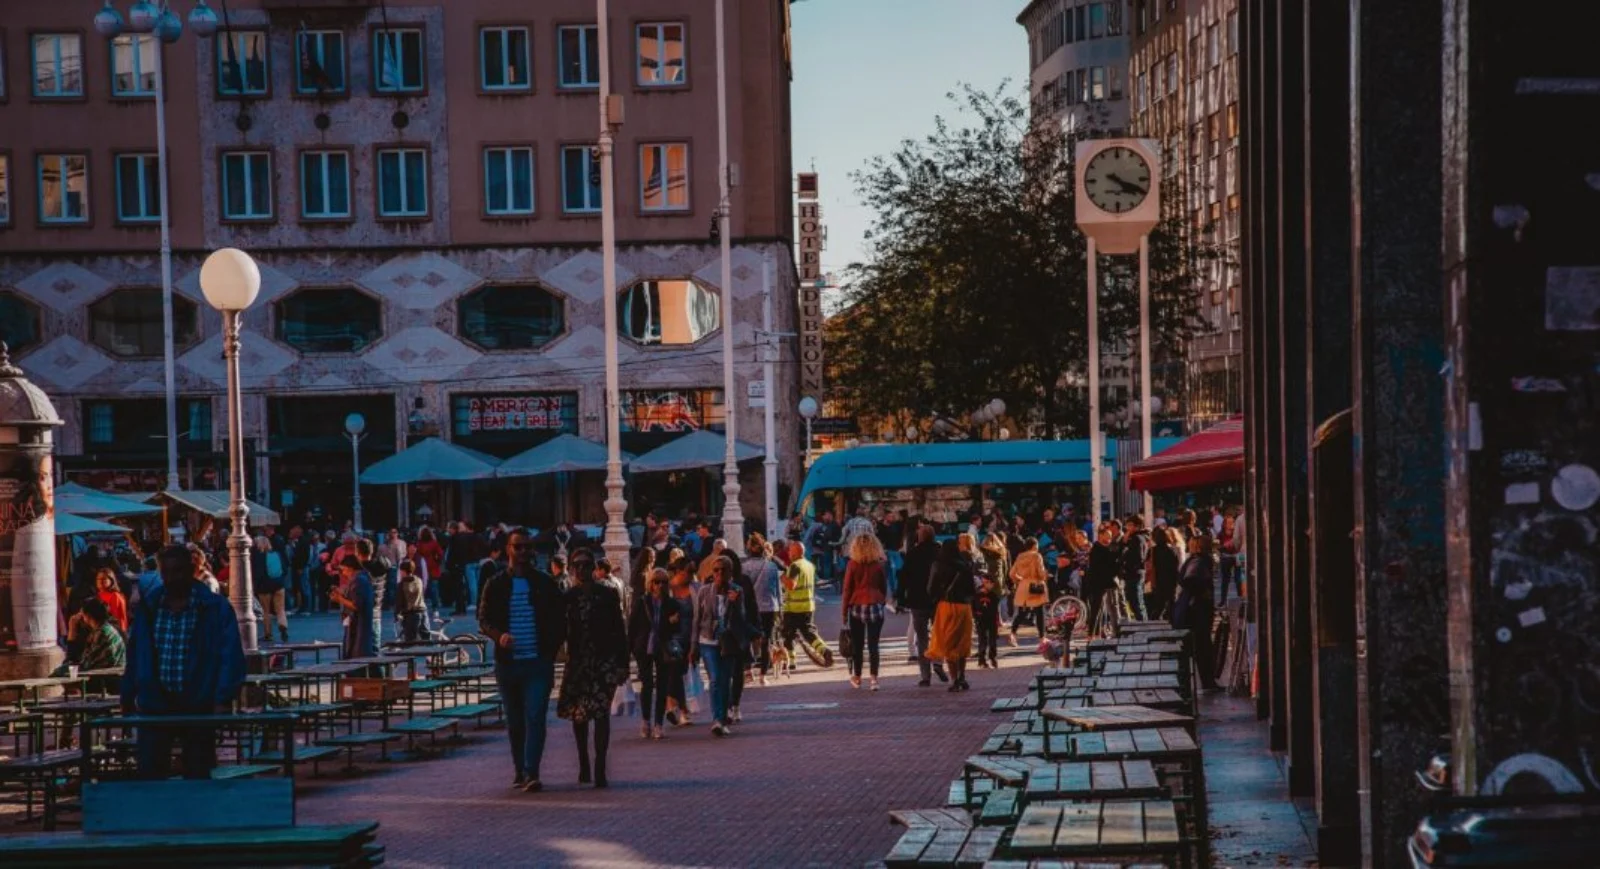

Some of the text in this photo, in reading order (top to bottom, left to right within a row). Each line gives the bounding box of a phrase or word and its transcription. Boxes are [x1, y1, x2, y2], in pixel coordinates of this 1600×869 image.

[801, 205, 817, 280] HOTEL
[803, 290, 820, 391] DUBROVN
[470, 396, 561, 413] AMERICAN
[527, 413, 563, 429] GRILL
